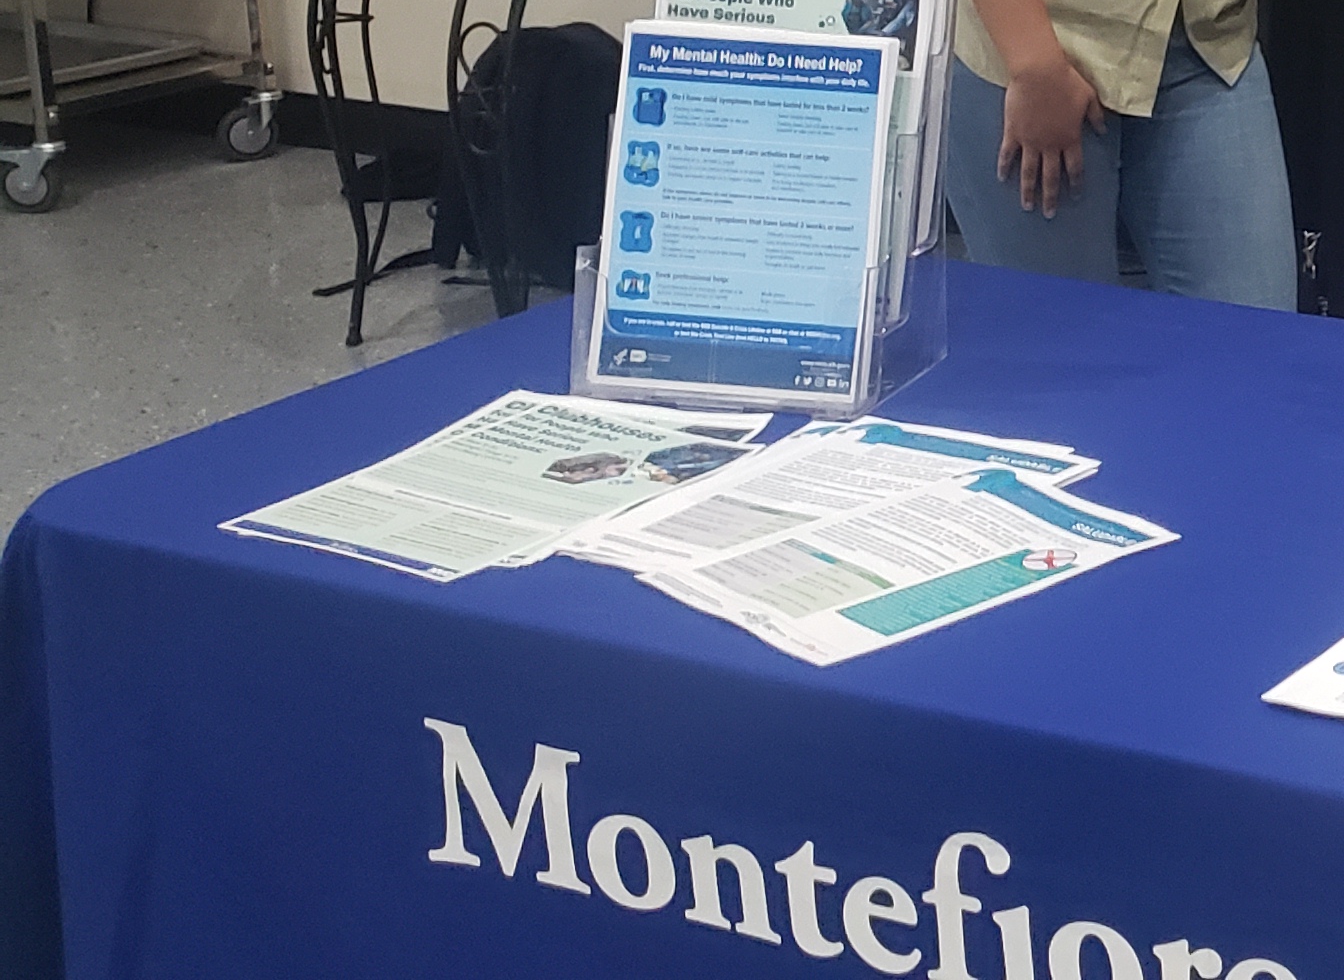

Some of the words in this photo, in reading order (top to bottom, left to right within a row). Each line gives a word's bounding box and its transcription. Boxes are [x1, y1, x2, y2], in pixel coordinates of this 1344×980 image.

[668, 4, 709, 21] Have
[713, 7, 775, 25] Serious
[649, 45, 670, 63] My
[673, 46, 717, 64] Mental
[720, 49, 765, 67] Health:
[768, 53, 785, 68] Do
[788, 54, 792, 68] I
[795, 55, 826, 71] Need
[829, 57, 863, 74] Help?
[537, 405, 667, 442] Clubhouses
[423, 716, 1298, 980] Montefior
